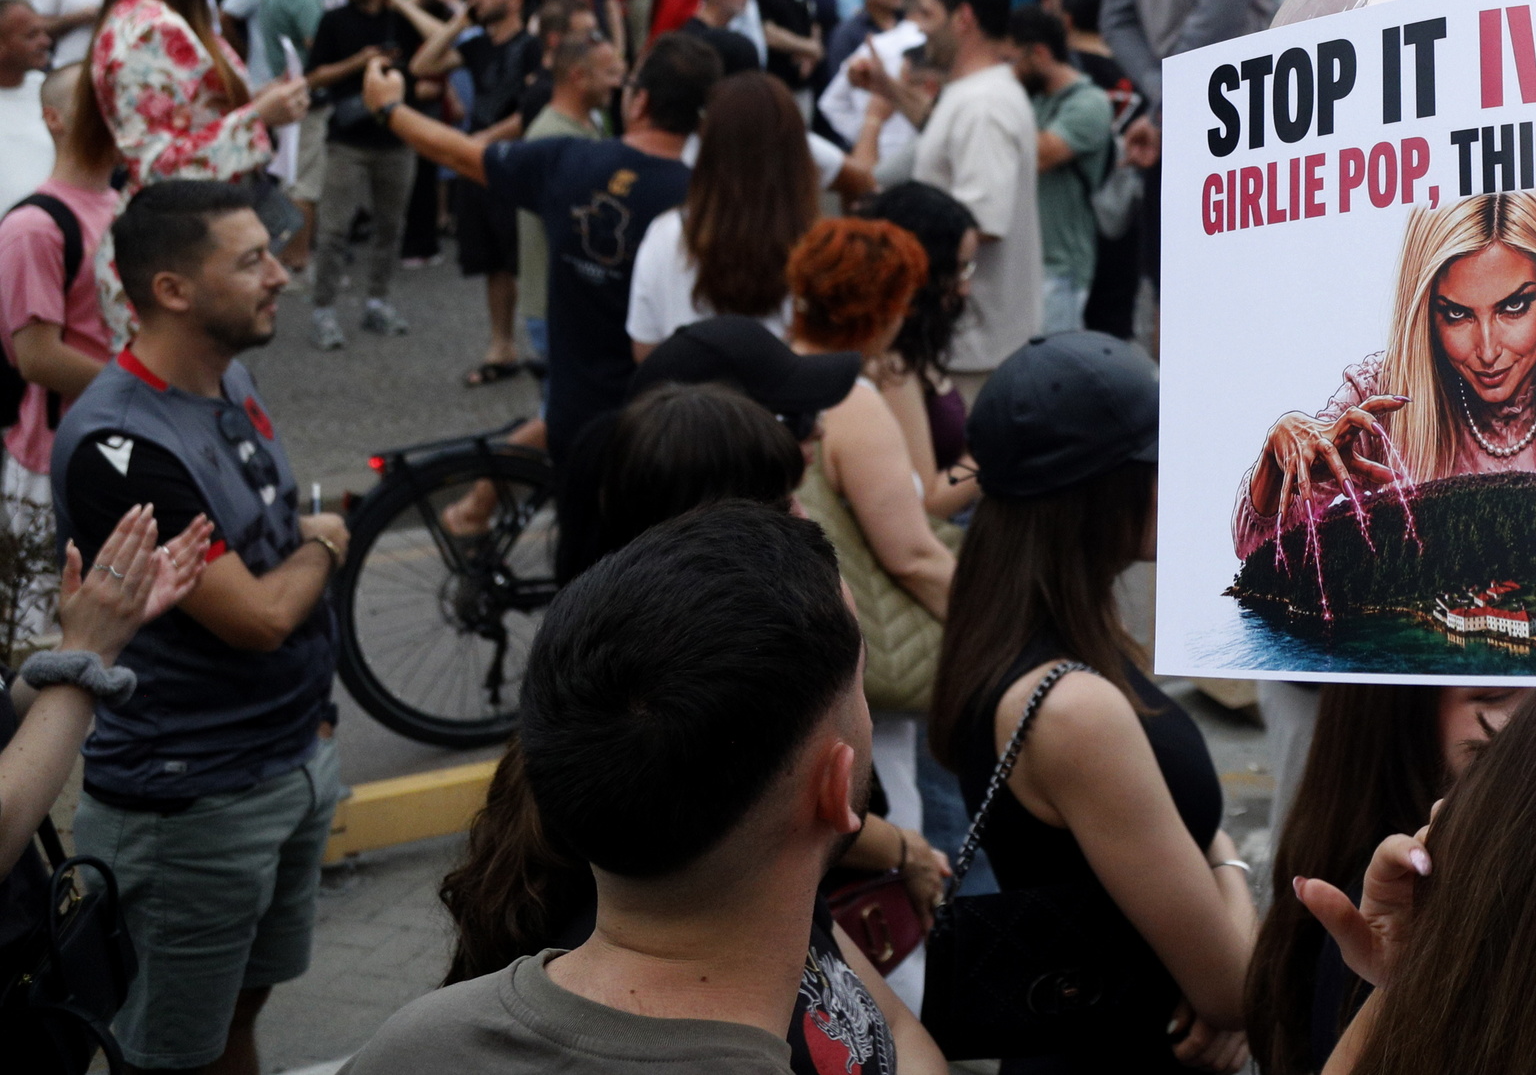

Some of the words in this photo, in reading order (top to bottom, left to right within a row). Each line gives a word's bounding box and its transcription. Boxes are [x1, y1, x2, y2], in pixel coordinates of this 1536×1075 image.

[1206, 38, 1357, 158] STOP
[1382, 16, 1447, 125] IT
[1201, 152, 1326, 236] GIRLIE
[1339, 136, 1442, 214] POP,
